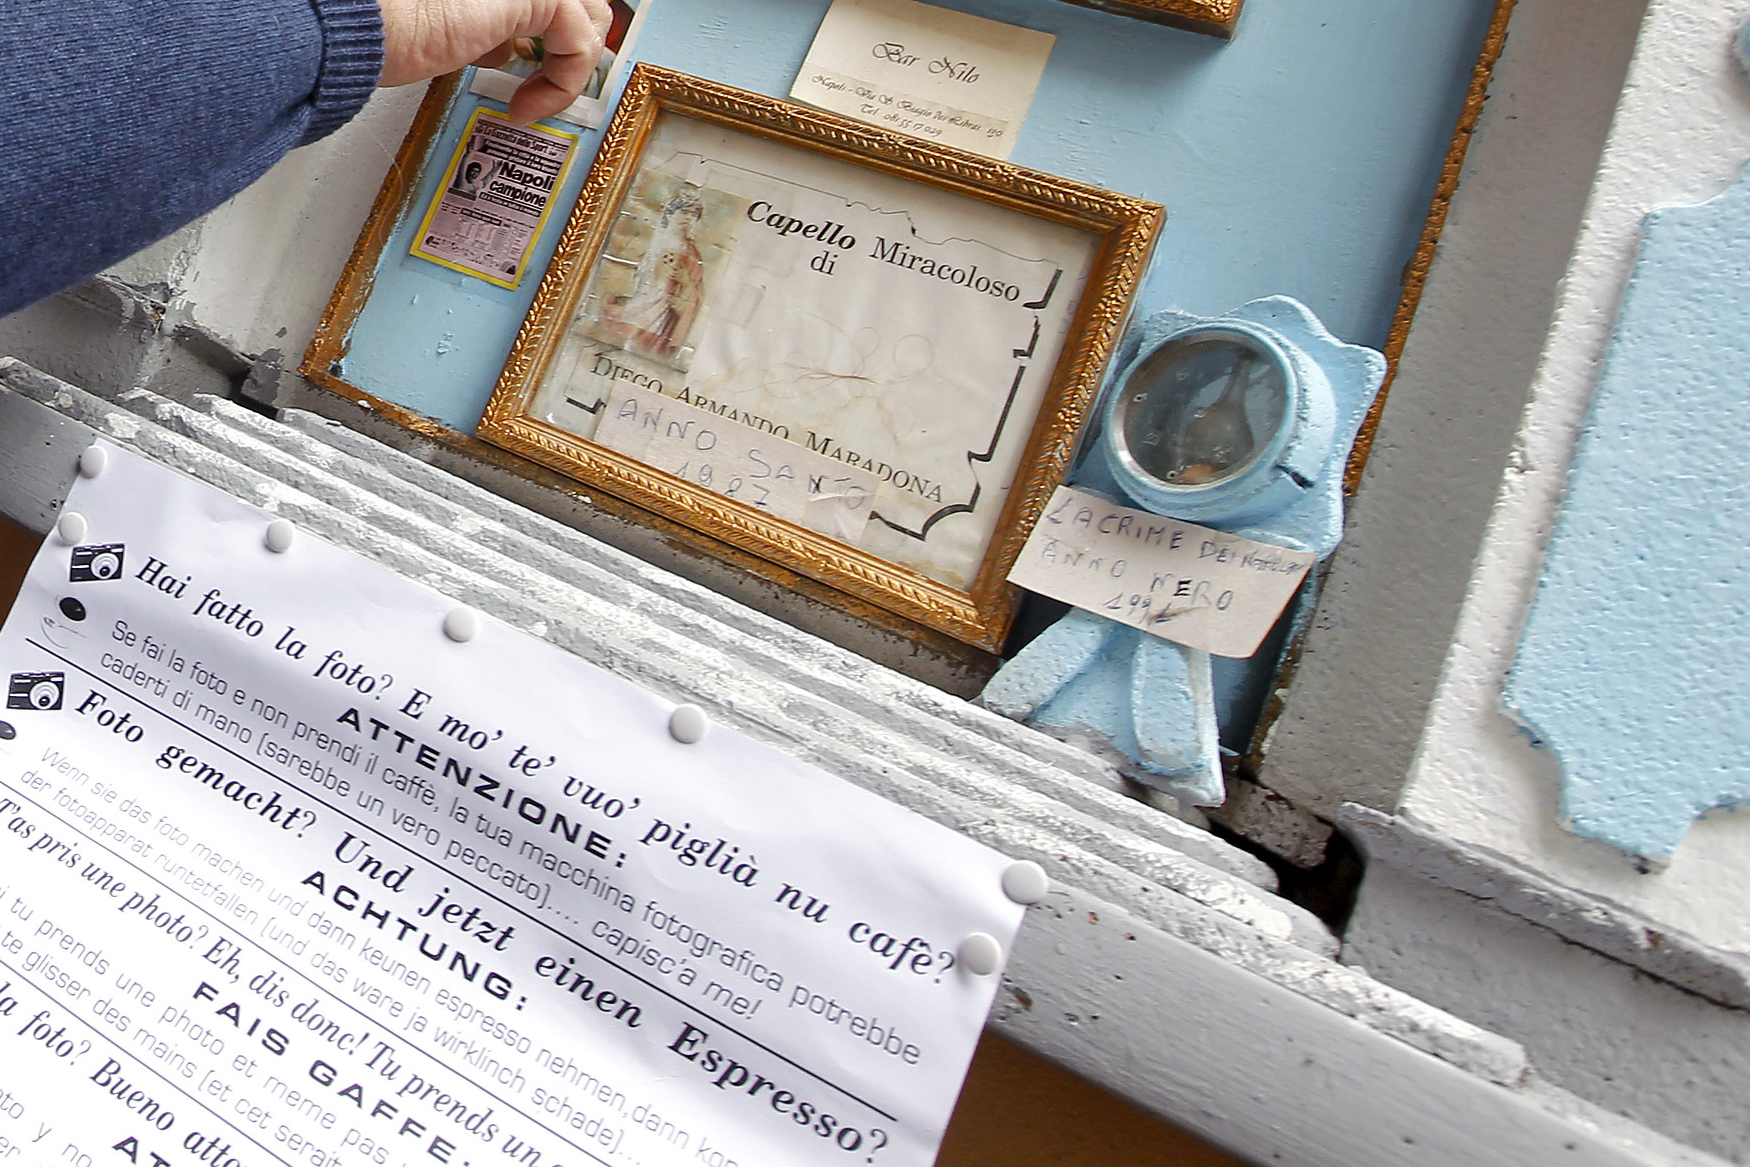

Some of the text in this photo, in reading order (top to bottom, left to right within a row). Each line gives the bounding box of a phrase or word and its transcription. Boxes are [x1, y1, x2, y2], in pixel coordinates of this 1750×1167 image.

[812, 74, 846, 90] Napoli
[872, 41, 981, 84] Bar Nilo
[489, 180, 547, 207] campione
[500, 161, 556, 191] Napoli
[747, 200, 1020, 302] Capello Miracoloso
[810, 250, 839, 275] di
[615, 398, 717, 450] ANNO
[804, 430, 944, 503] MARADONA
[673, 462, 770, 508] 1987
[1046, 498, 1182, 550] LACRIME
[1040, 537, 1234, 612] ANNO NERO
[134, 556, 192, 599] Hai
[191, 589, 264, 637] fatto
[274, 626, 308, 660] la
[312, 650, 394, 701] foto?
[398, 688, 433, 720] E
[437, 714, 504, 750] mo'
[508, 745, 556, 777] te'
[562, 776, 641, 818] vuo'
[638, 818, 760, 888] piglià
[774, 883, 830, 923] nu
[334, 707, 628, 869] ATTENZIONE:
[100, 653, 171, 698] caderti
[171, 689, 194, 711] di
[194, 703, 253, 744] mano
[356, 791, 385, 817] un
[392, 808, 441, 846] vero
[702, 981, 762, 1020] me!
[111, 620, 921, 1065] Se fai la foto e non prendi il caffè, la tua macchina fotografica potrebbe
[20, 771, 52, 792] der
[53, 787, 153, 858] fotoapparat
[311, 952, 348, 983] das
[353, 978, 404, 1018] ware
[404, 1012, 428, 1033] ja
[41, 747, 531, 1054] Wenn sie das foto machen und dann keunen espresso
[74, 689, 889, 1164] Foto gemacht? Und jetzt einen Espresso?
[300, 870, 529, 1011] ACHTUNG:
[1, 930, 23, 955] te
[22, 951, 91, 1000] glisser
[93, 998, 131, 1032] des
[133, 1028, 197, 1078] mains
[234, 1098, 272, 1130] cet
[10, 897, 34, 921] tu
[34, 919, 110, 975] prends
[115, 973, 156, 1008] une
[158, 1006, 225, 1056] photo
[232, 1054, 258, 1078] et
[263, 1076, 336, 1130] meme
[340, 1128, 389, 1165] pas
[26, 832, 82, 868] pris
[80, 862, 126, 898] une
[117, 891, 209, 949] photo?
[201, 936, 243, 984] Eh,
[248, 970, 290, 1008] dis
[290, 998, 370, 1056] donc!
[364, 1041, 402, 1081] Tu
[396, 1073, 500, 1143] prends
[501, 1134, 542, 1166] un
[192, 981, 290, 1056] FAIS
[16, 1010, 92, 1066] foto?
[88, 1057, 175, 1131] Bueno
[31, 1122, 52, 1143] y
